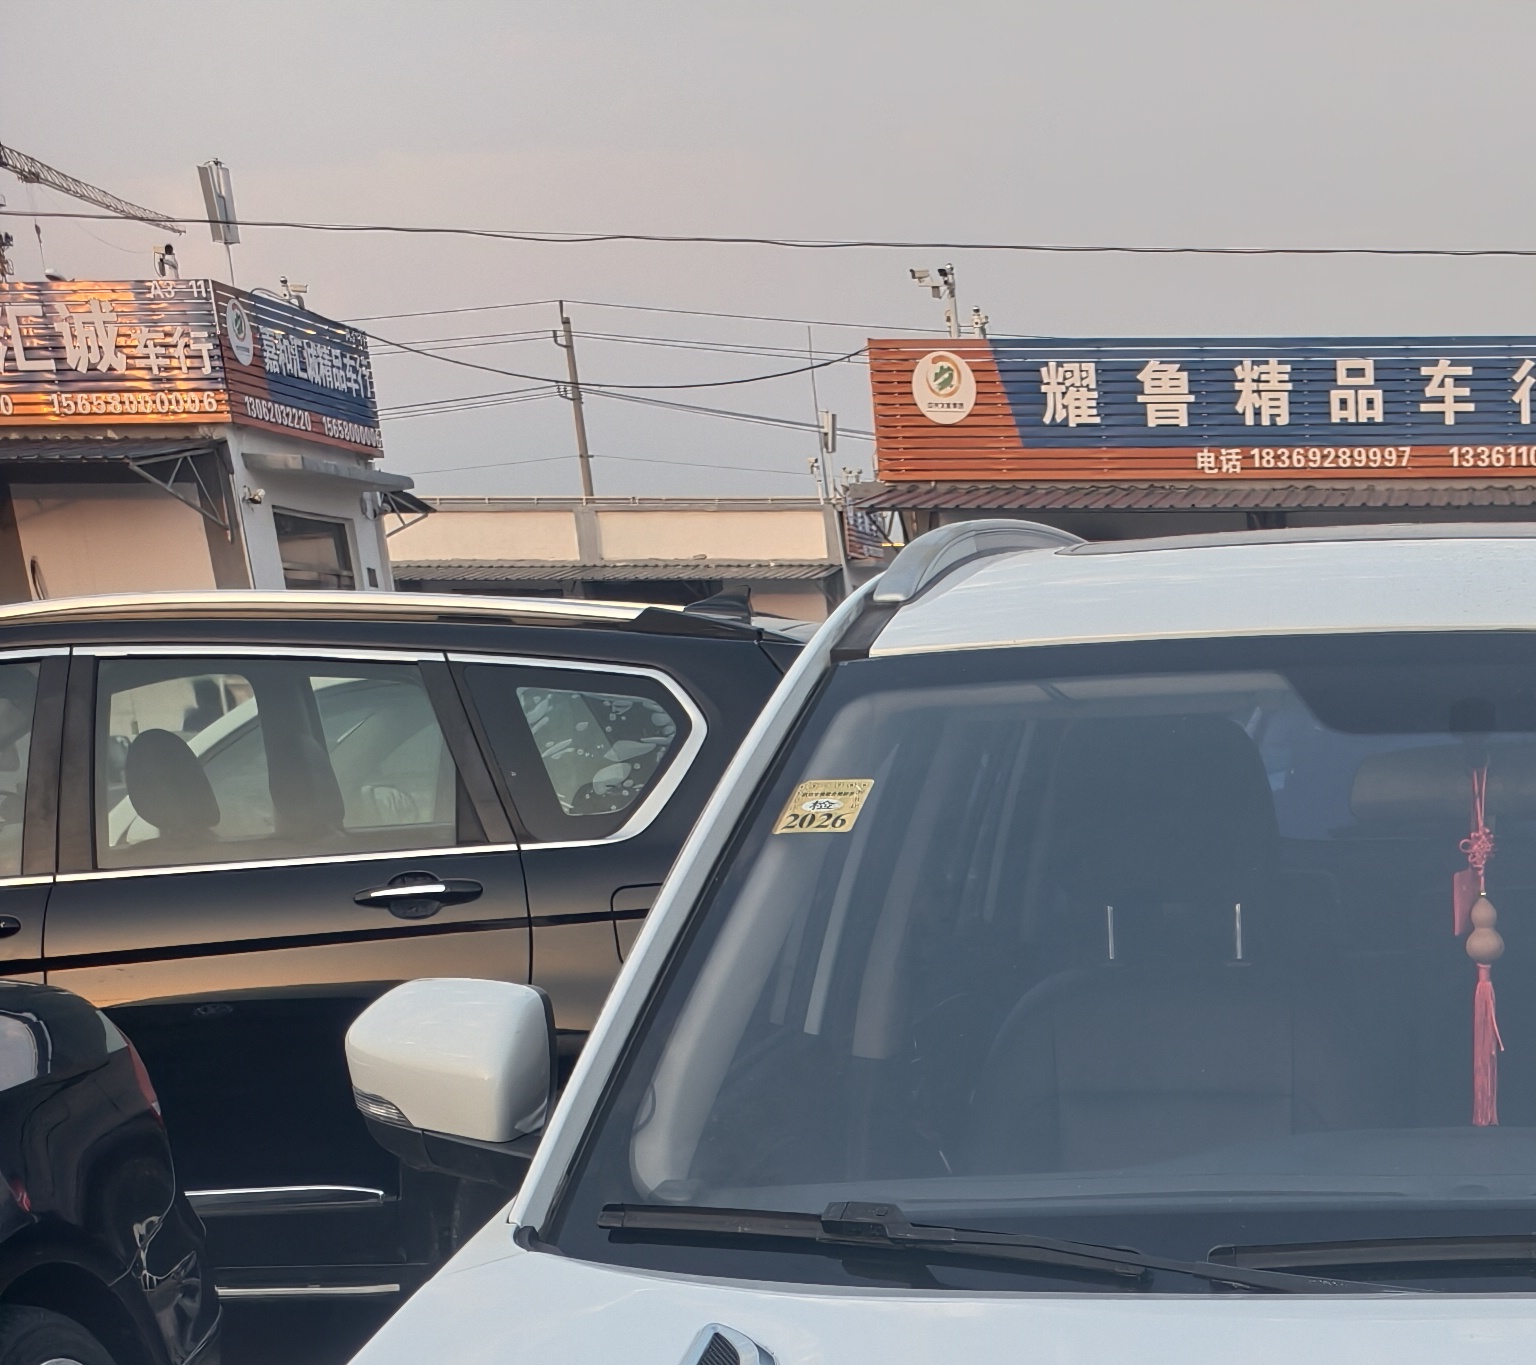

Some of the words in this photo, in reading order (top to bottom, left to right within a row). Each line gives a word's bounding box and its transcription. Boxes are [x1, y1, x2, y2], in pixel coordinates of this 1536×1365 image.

[244, 395, 312, 432] 13062032220
[1196, 447, 1242, 475] 电话
[1251, 445, 1412, 469] 18369289997
[781, 812, 852, 830] 2026
